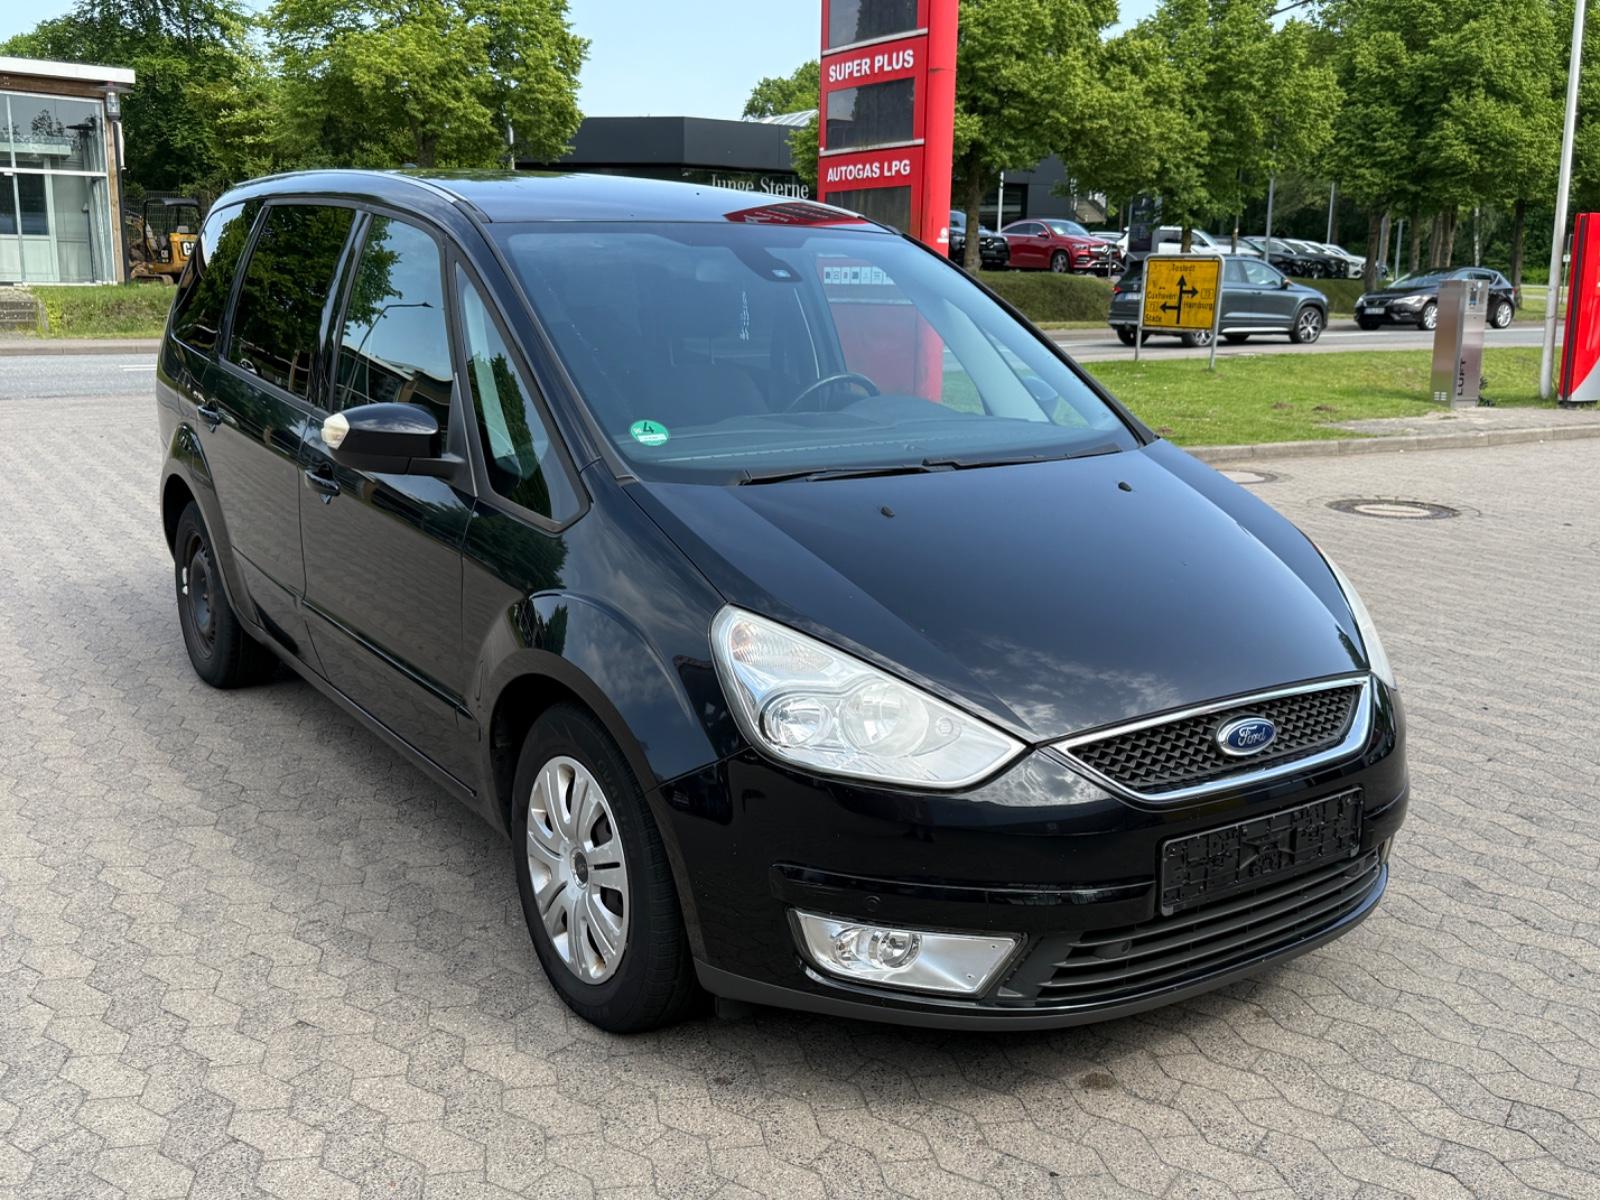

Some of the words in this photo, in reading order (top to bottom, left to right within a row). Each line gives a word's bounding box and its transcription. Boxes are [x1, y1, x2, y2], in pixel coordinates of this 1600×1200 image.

[829, 57, 870, 82] SUPER
[874, 49, 914, 74] PLUS
[827, 161, 880, 182] AUTOGAS
[883, 159, 911, 177] LPG
[711, 174, 755, 192] Junge
[760, 177, 809, 199] Sterne
[1147, 291, 1176, 300] Cuxhaven
[1457, 358, 1466, 396] LUFT
[643, 421, 654, 434] 4
[1238, 725, 1266, 746] Ford
